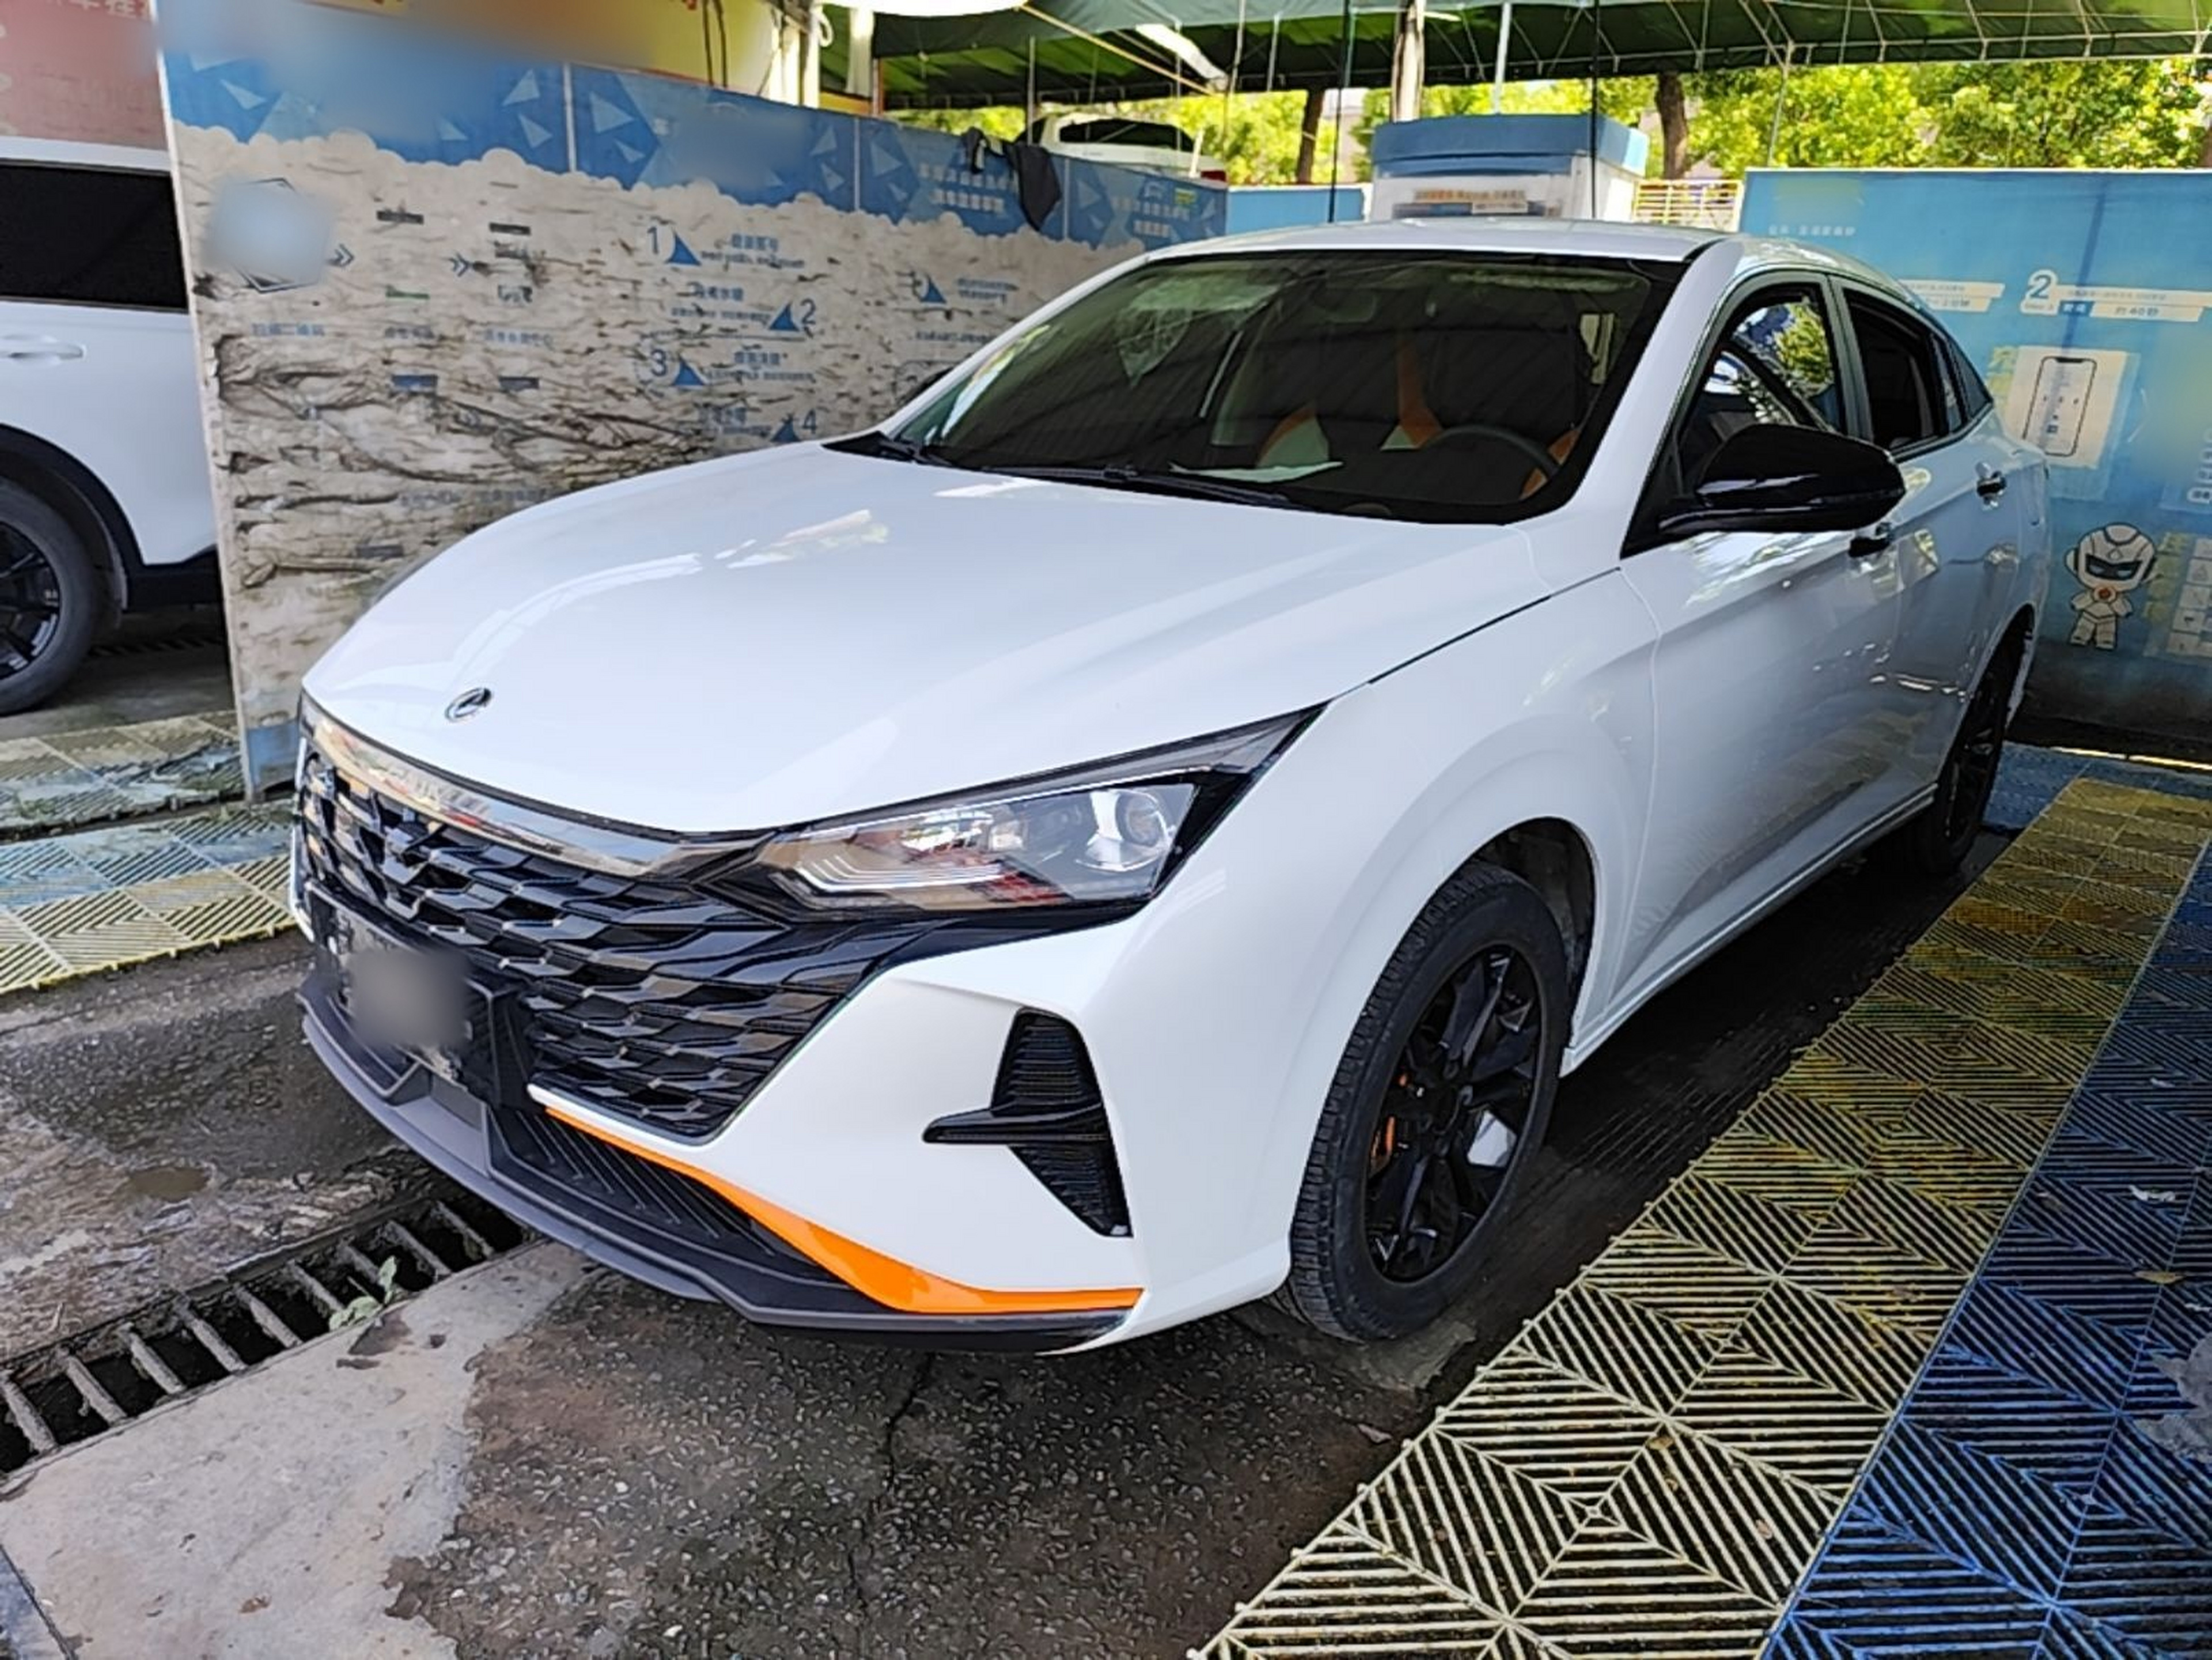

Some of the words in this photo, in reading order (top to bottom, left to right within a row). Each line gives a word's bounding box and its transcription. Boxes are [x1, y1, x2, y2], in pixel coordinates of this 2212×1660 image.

[646, 226, 659, 255] 1
[2029, 273, 2053, 300] 2
[800, 298, 816, 325] 2
[650, 349, 667, 377] 3
[802, 410, 817, 434] 4
